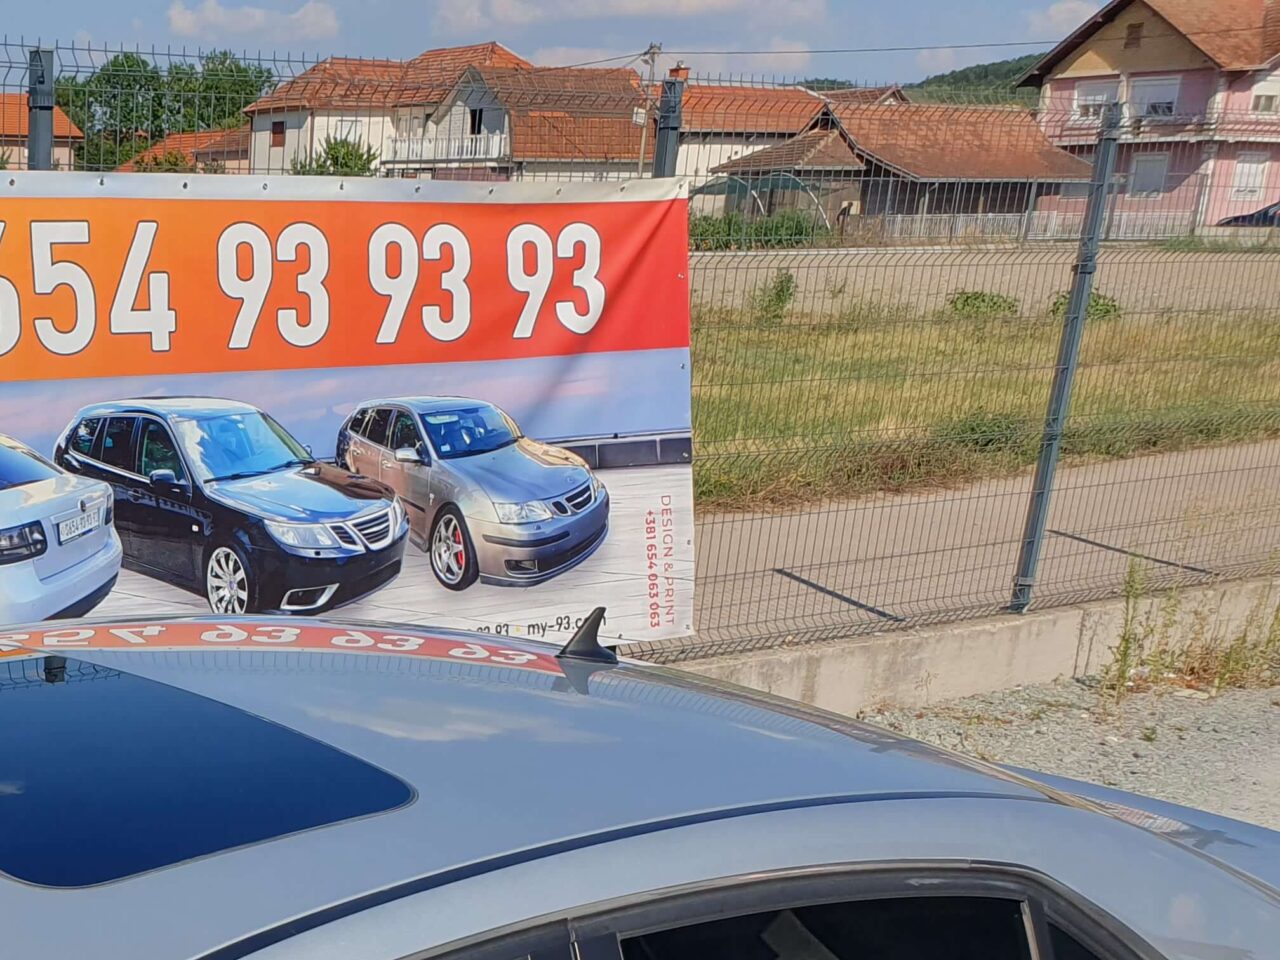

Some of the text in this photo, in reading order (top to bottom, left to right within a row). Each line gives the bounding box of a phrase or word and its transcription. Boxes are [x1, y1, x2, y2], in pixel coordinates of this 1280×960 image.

[216, 221, 330, 350] 93
[367, 222, 473, 344] 93
[505, 222, 606, 340] 93
[645, 510, 660, 628] +381 654 063 063
[660, 495, 675, 624] DESIGN & PRINT
[527, 615, 607, 637] my-93.c
